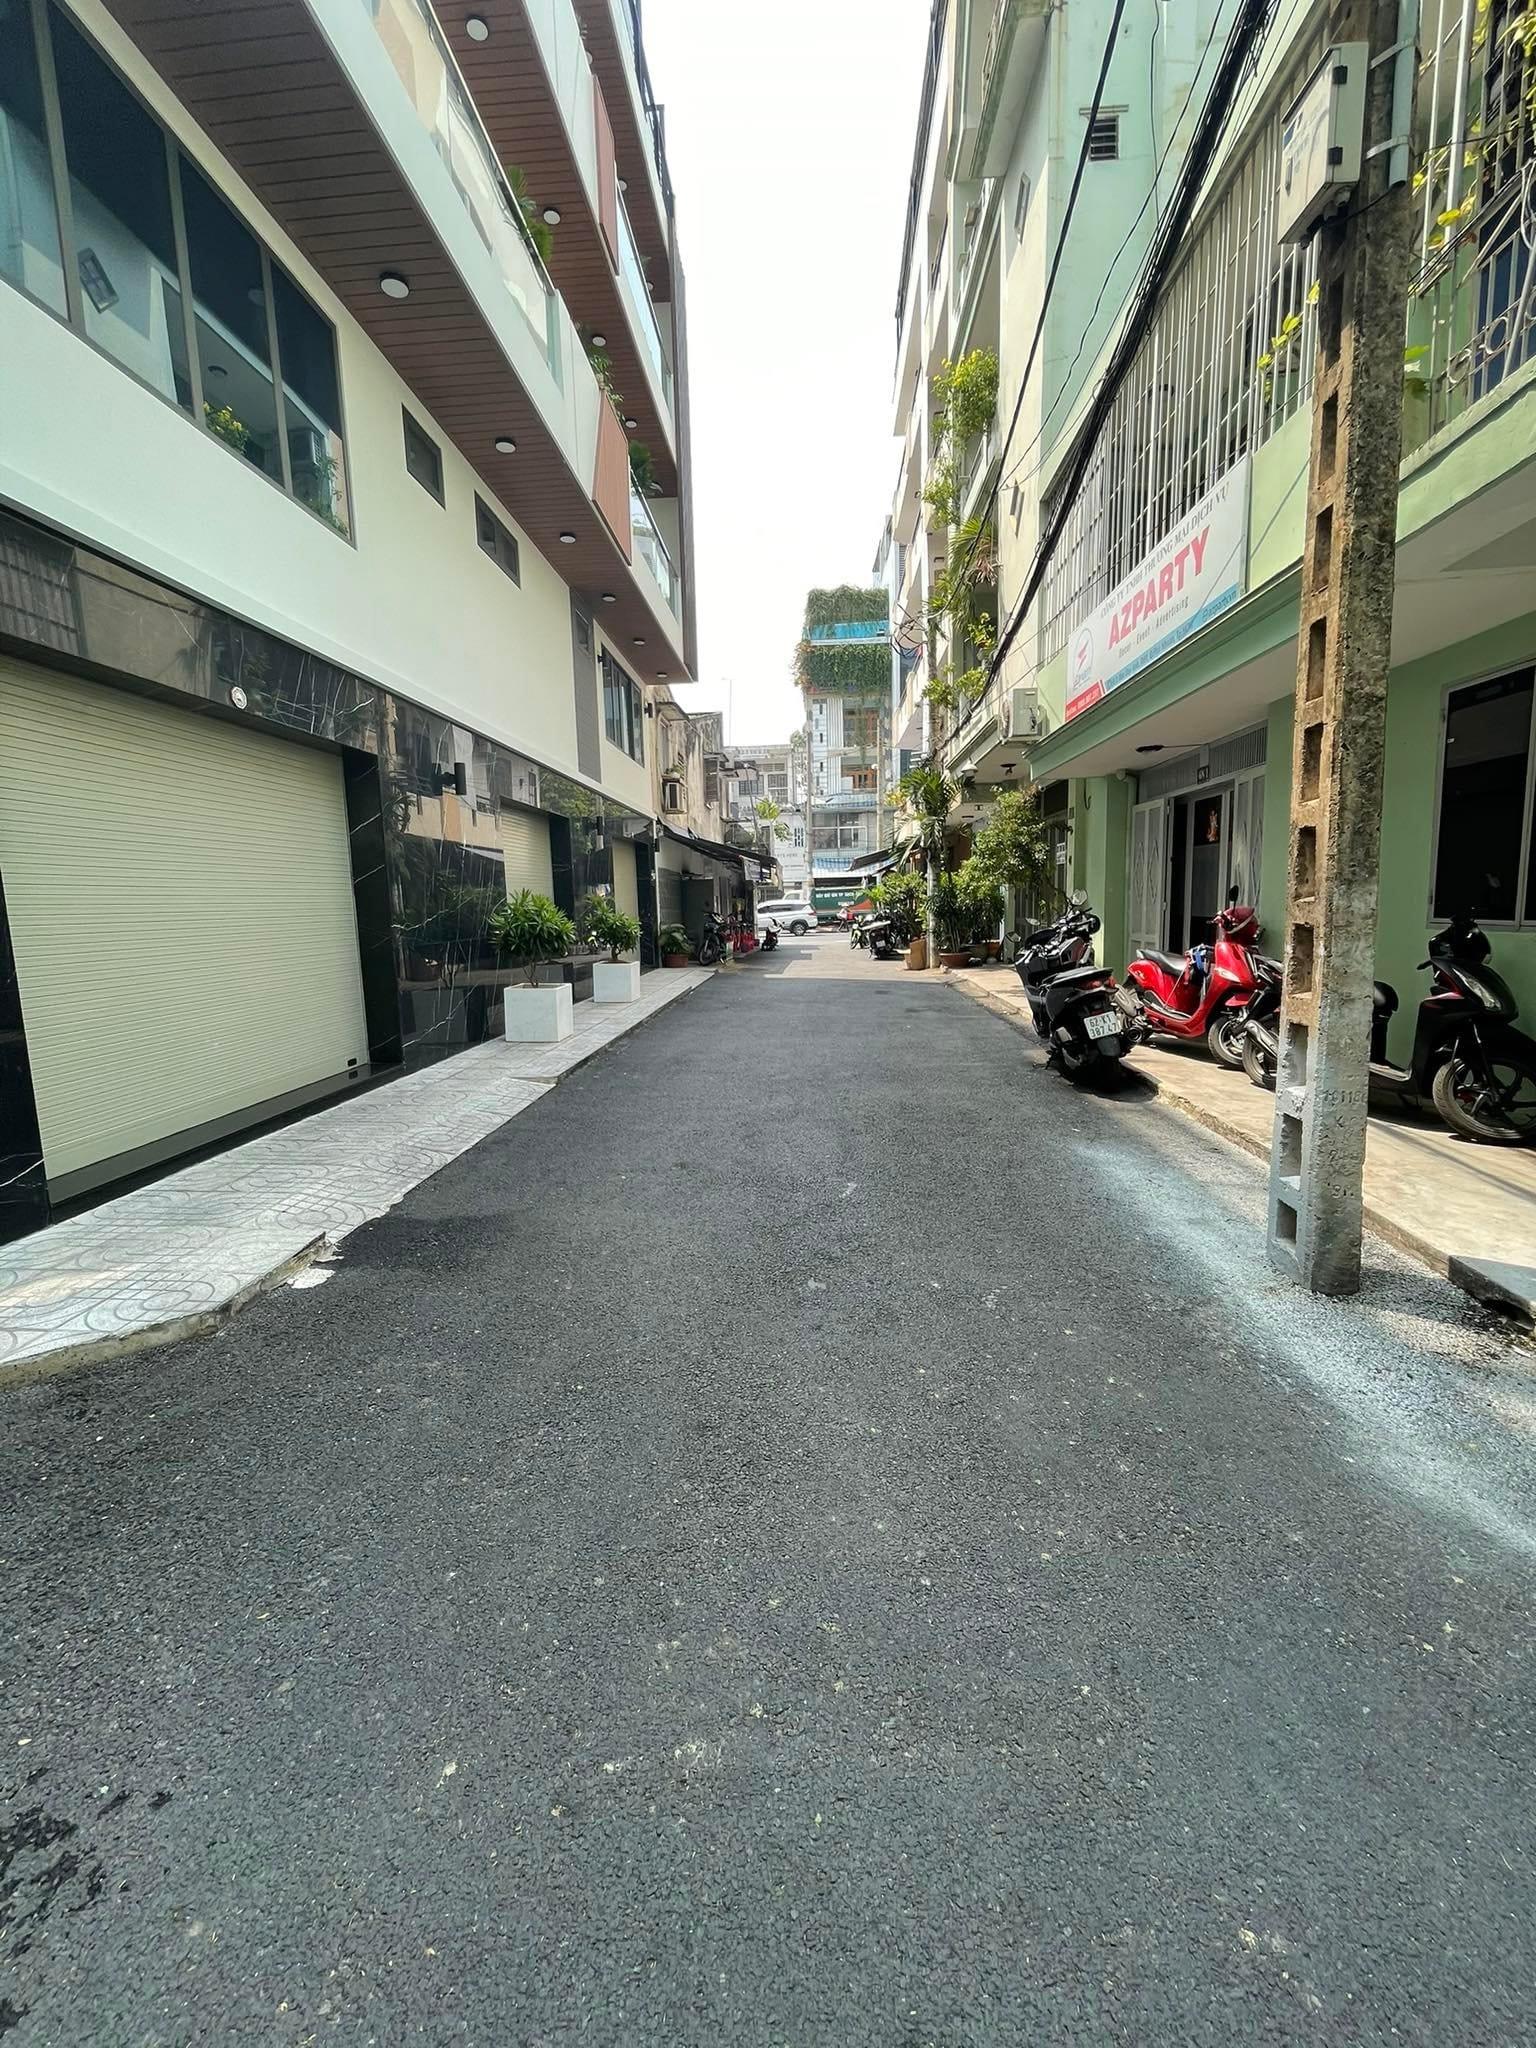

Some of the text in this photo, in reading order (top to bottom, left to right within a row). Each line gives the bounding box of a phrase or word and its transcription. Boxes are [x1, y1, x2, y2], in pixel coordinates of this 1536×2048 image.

[1107, 524, 1211, 651] AZPARTY
[1156, 596, 1190, 629] Advertising
[1090, 1022, 1117, 1038] 387.47
